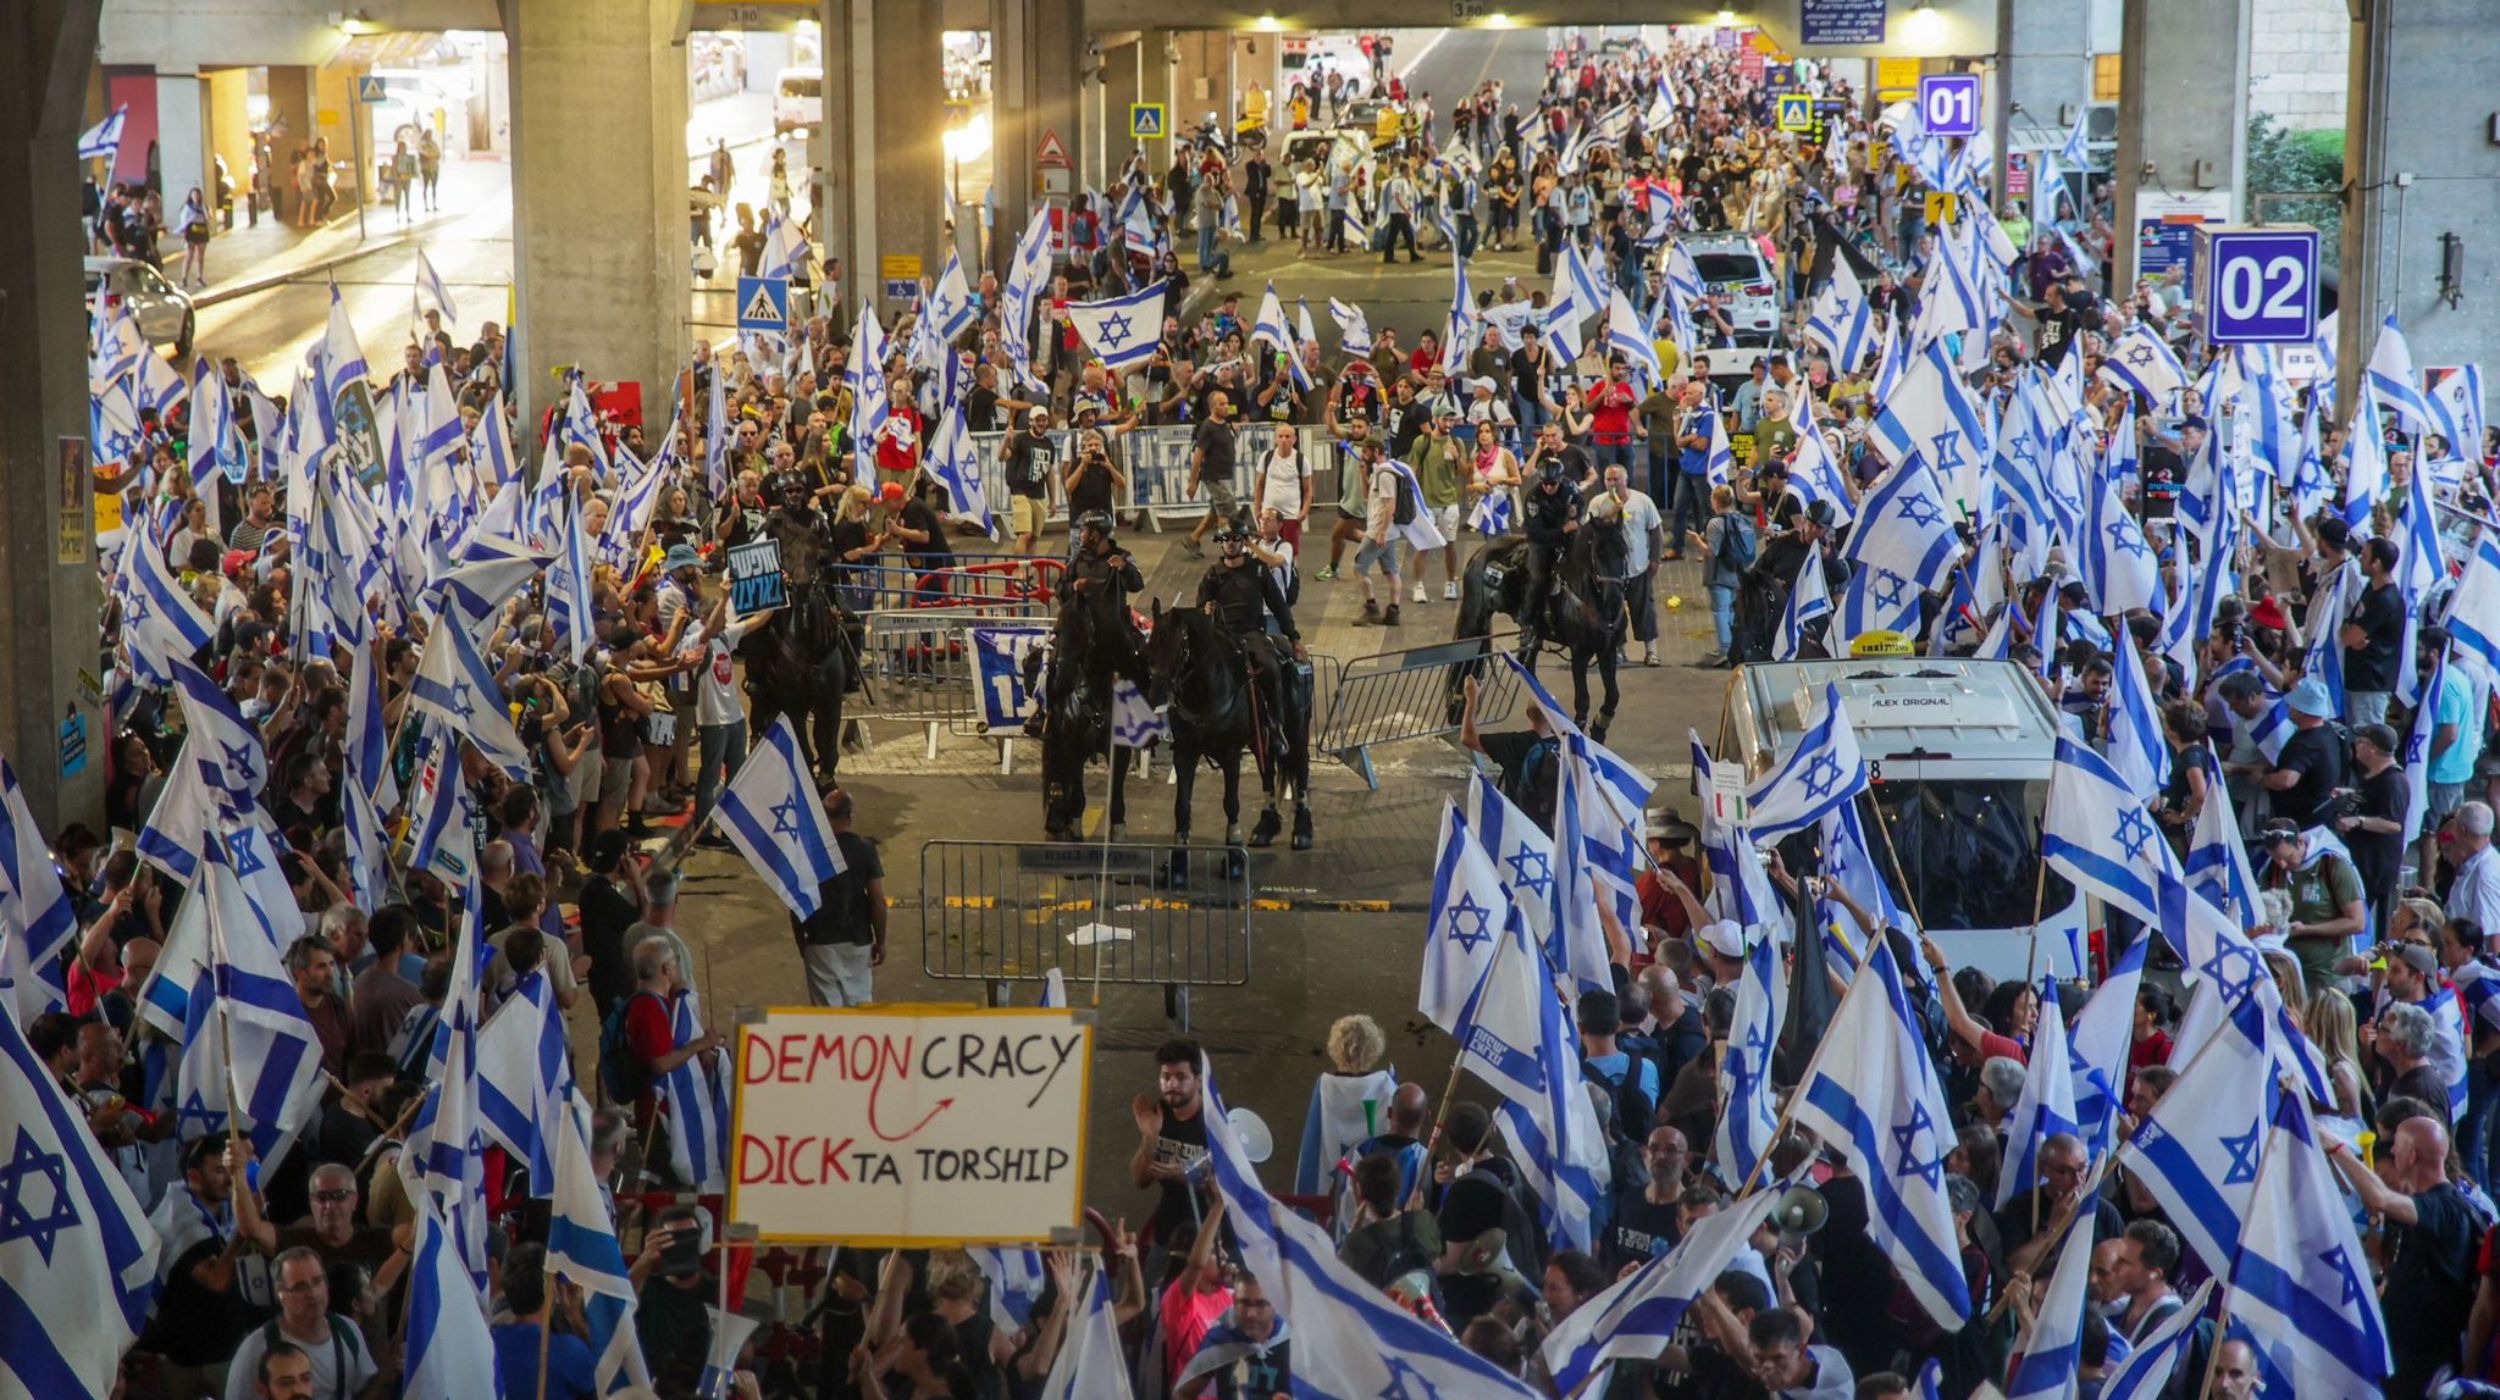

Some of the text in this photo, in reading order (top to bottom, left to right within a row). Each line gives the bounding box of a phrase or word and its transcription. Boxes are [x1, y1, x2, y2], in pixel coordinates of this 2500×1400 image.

[1930, 87, 1972, 125] 01
[2221, 256, 2305, 320] 02
[1871, 697, 1950, 708] ALEX ORIGINAL
[915, 1146, 1069, 1183] TORSHIP
